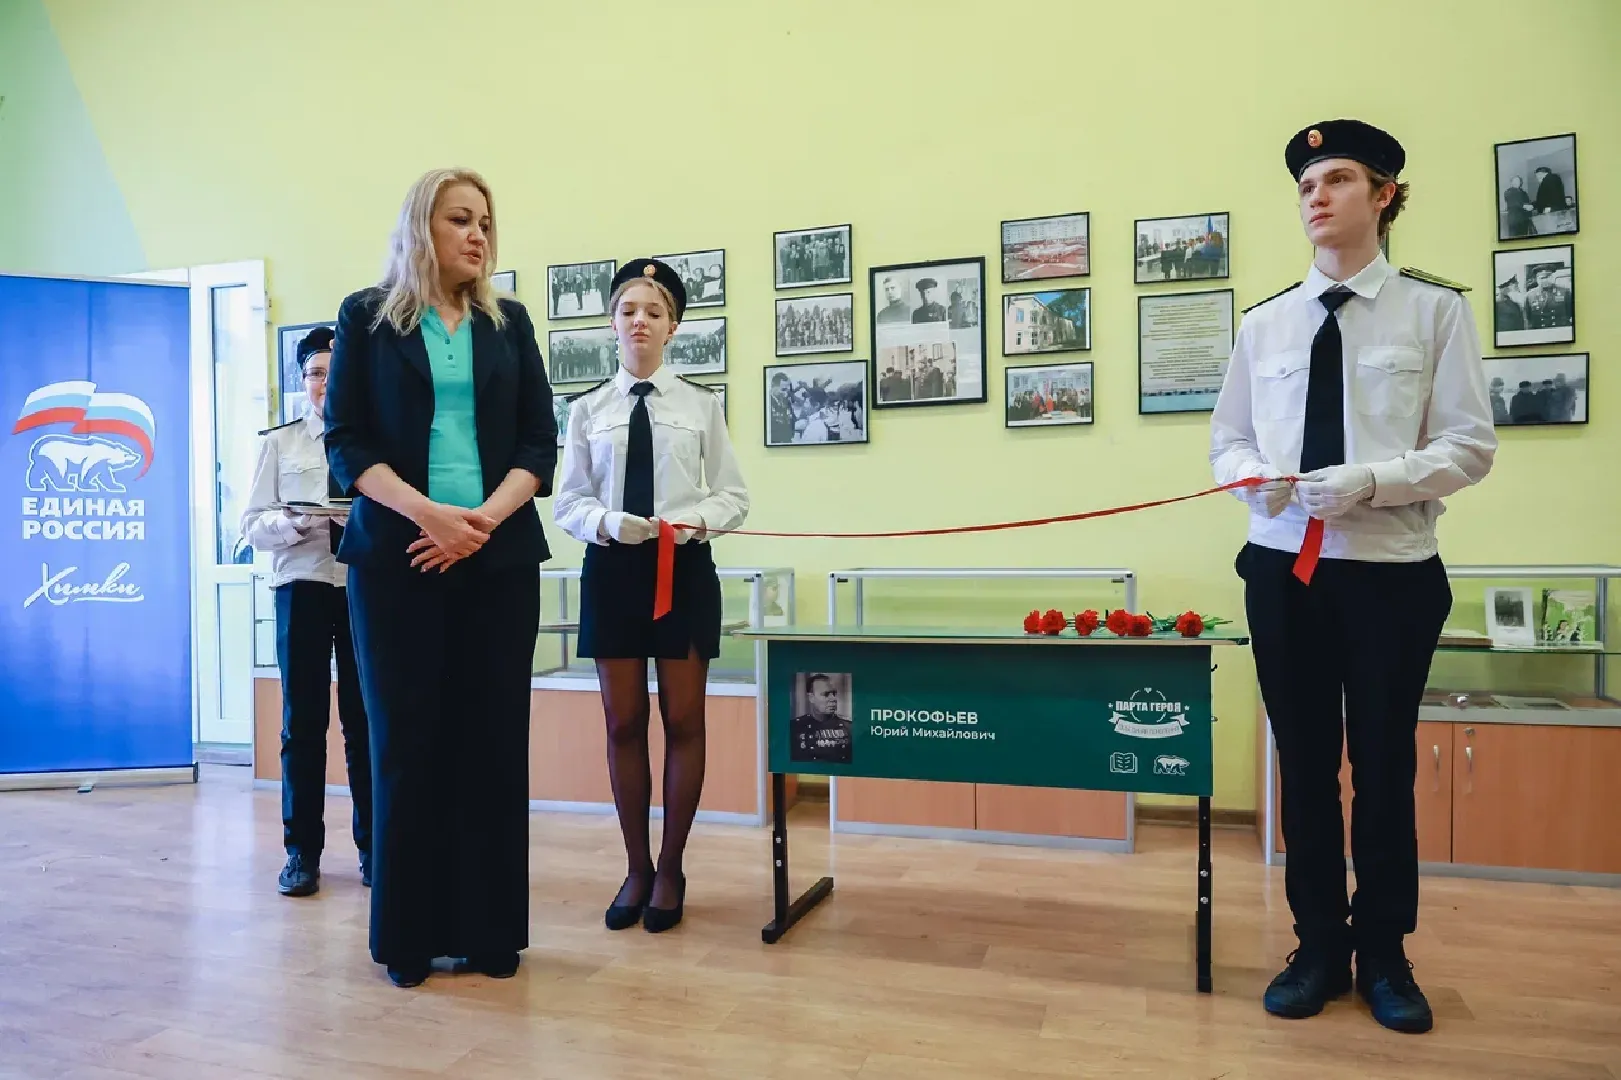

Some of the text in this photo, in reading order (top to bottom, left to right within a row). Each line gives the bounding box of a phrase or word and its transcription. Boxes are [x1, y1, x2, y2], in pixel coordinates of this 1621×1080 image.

[22, 497, 145, 518] ЕДИНАЯ
[23, 520, 145, 540] РОССИЯ
[24, 561, 145, 609] Химки
[1115, 700, 1182, 713] ПАРТА ГЕРОЯ
[870, 708, 979, 726] ПРОКОФЬЕВ
[870, 725, 996, 742] Юрий Михайлович
